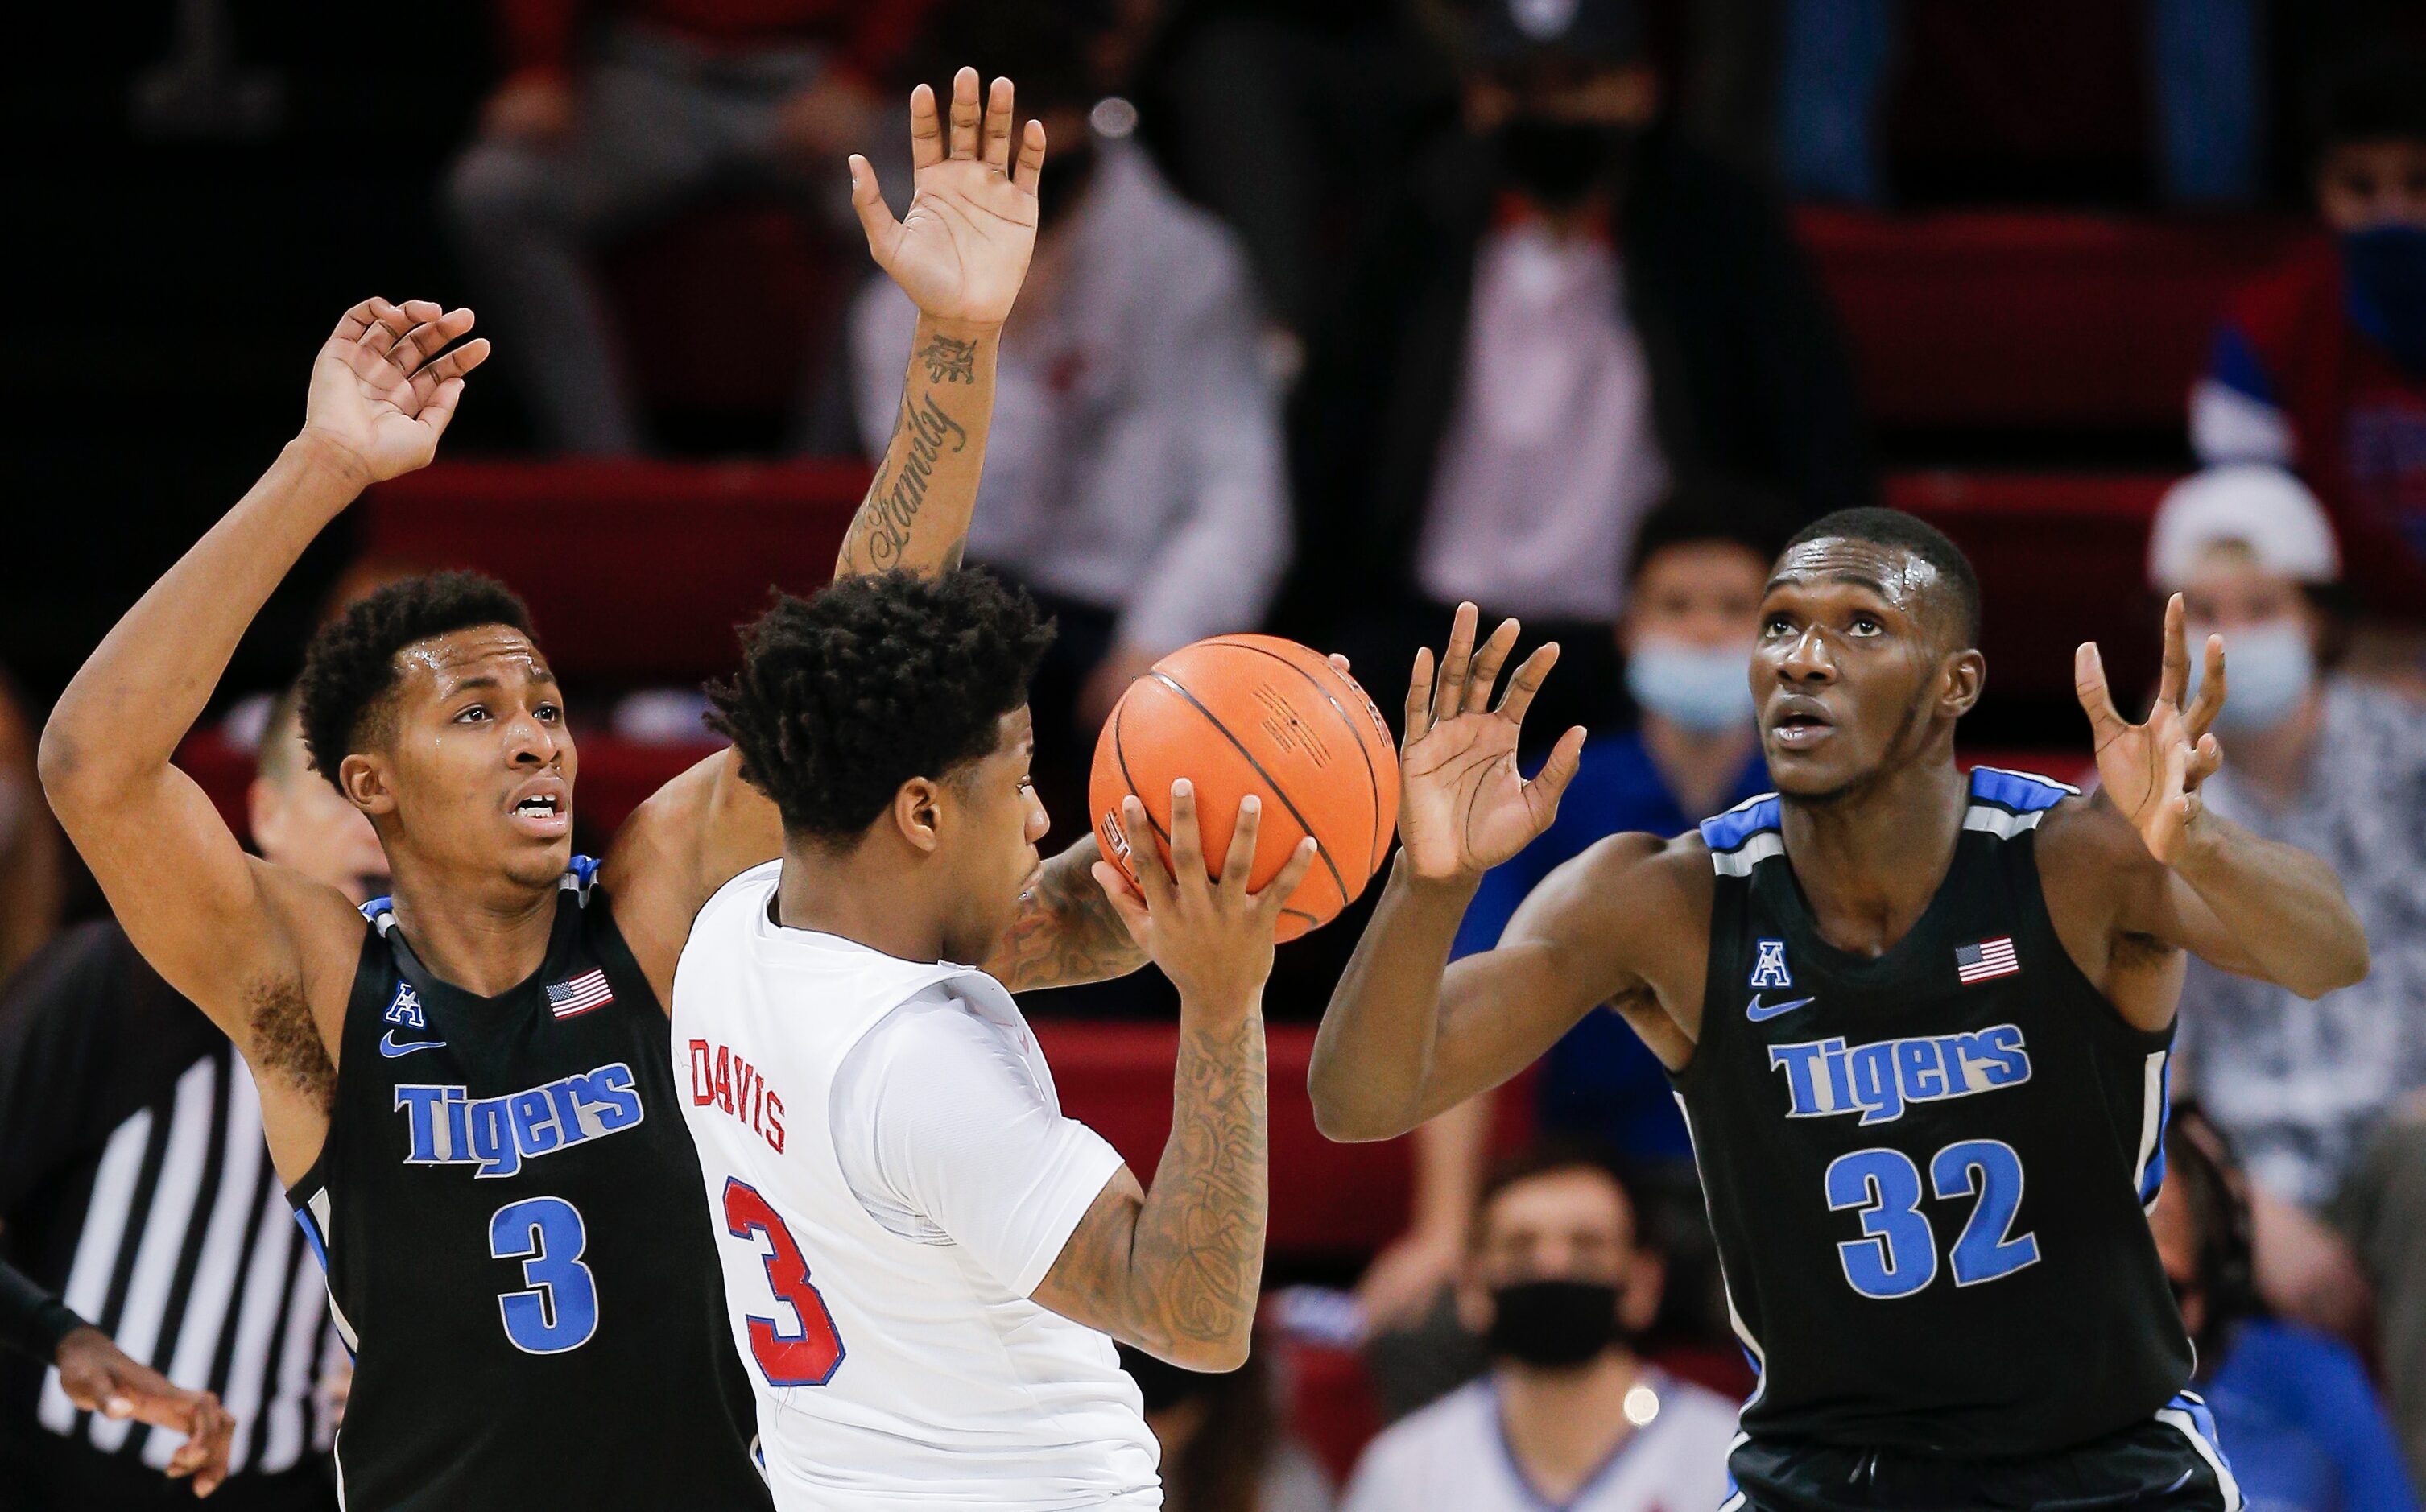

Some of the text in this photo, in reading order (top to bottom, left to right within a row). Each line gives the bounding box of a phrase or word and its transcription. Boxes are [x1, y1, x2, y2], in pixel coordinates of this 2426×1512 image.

[869, 378, 967, 572] Family
[394, 1062, 644, 1179] Tigers
[688, 1039, 786, 1155] DAVIS
[1767, 1023, 2031, 1126] Tigers
[489, 1196, 599, 1355] 3
[722, 1175, 846, 1387] 3
[1825, 1138, 2041, 1300] 32
